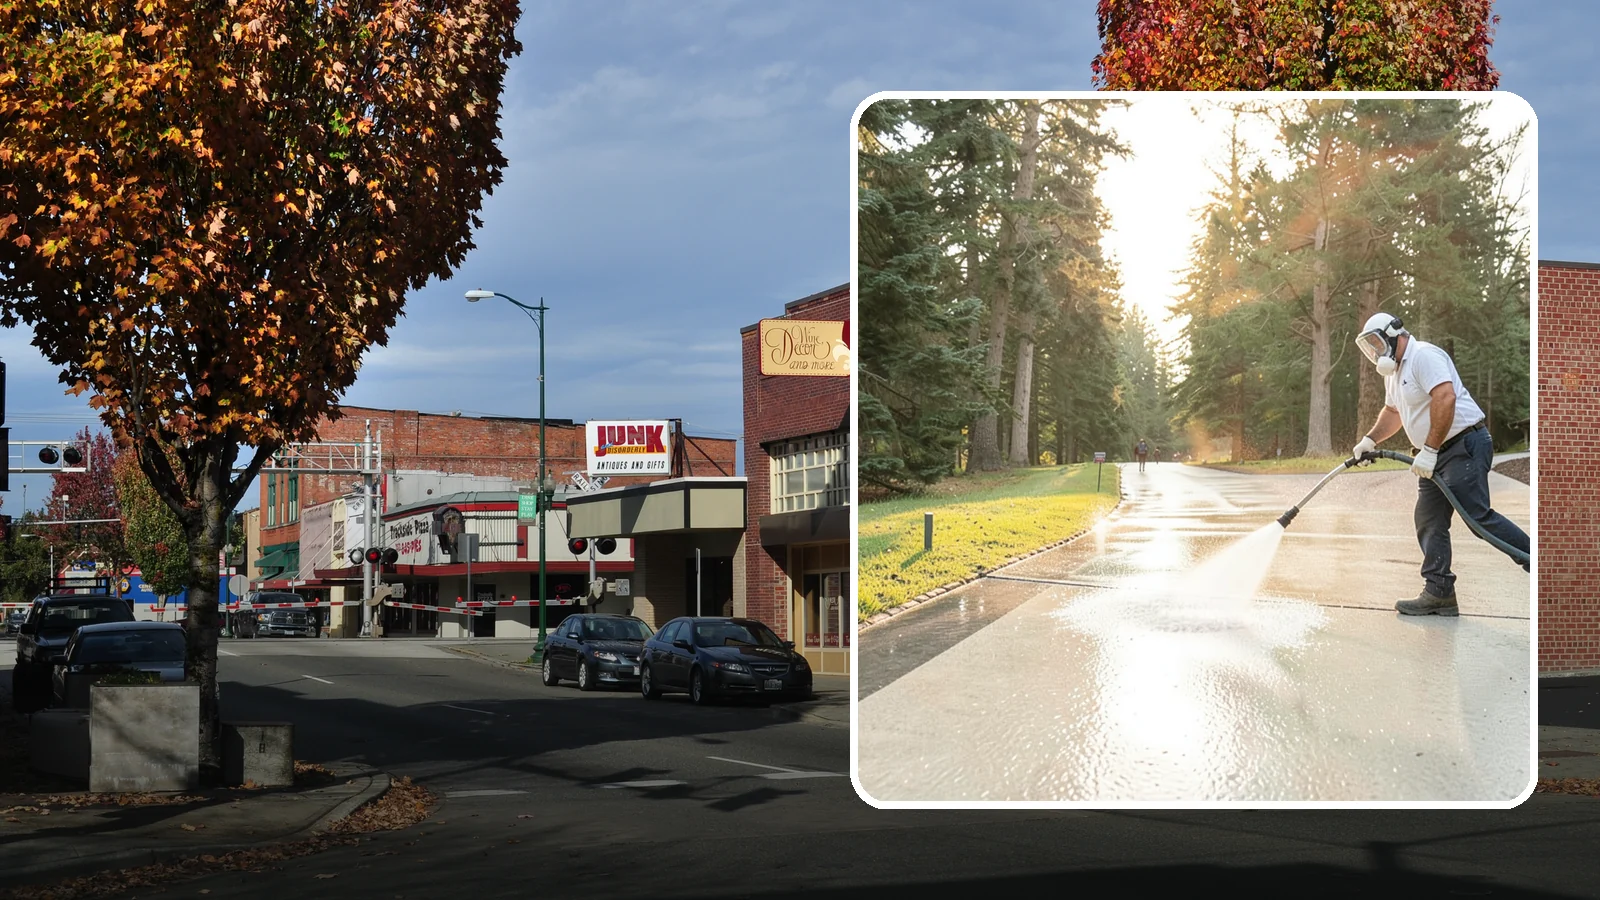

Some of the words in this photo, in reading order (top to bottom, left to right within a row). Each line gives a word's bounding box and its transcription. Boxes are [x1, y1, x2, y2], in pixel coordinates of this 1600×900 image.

[595, 425, 665, 457] JUNK
[607, 446, 646, 454] DISORDERLY
[597, 461, 628, 470] ANTIQUES
[631, 461, 644, 470] AND
[647, 460, 665, 469] GIFTS
[590, 476, 608, 491] SING
[415, 520, 429, 534] Pizza
